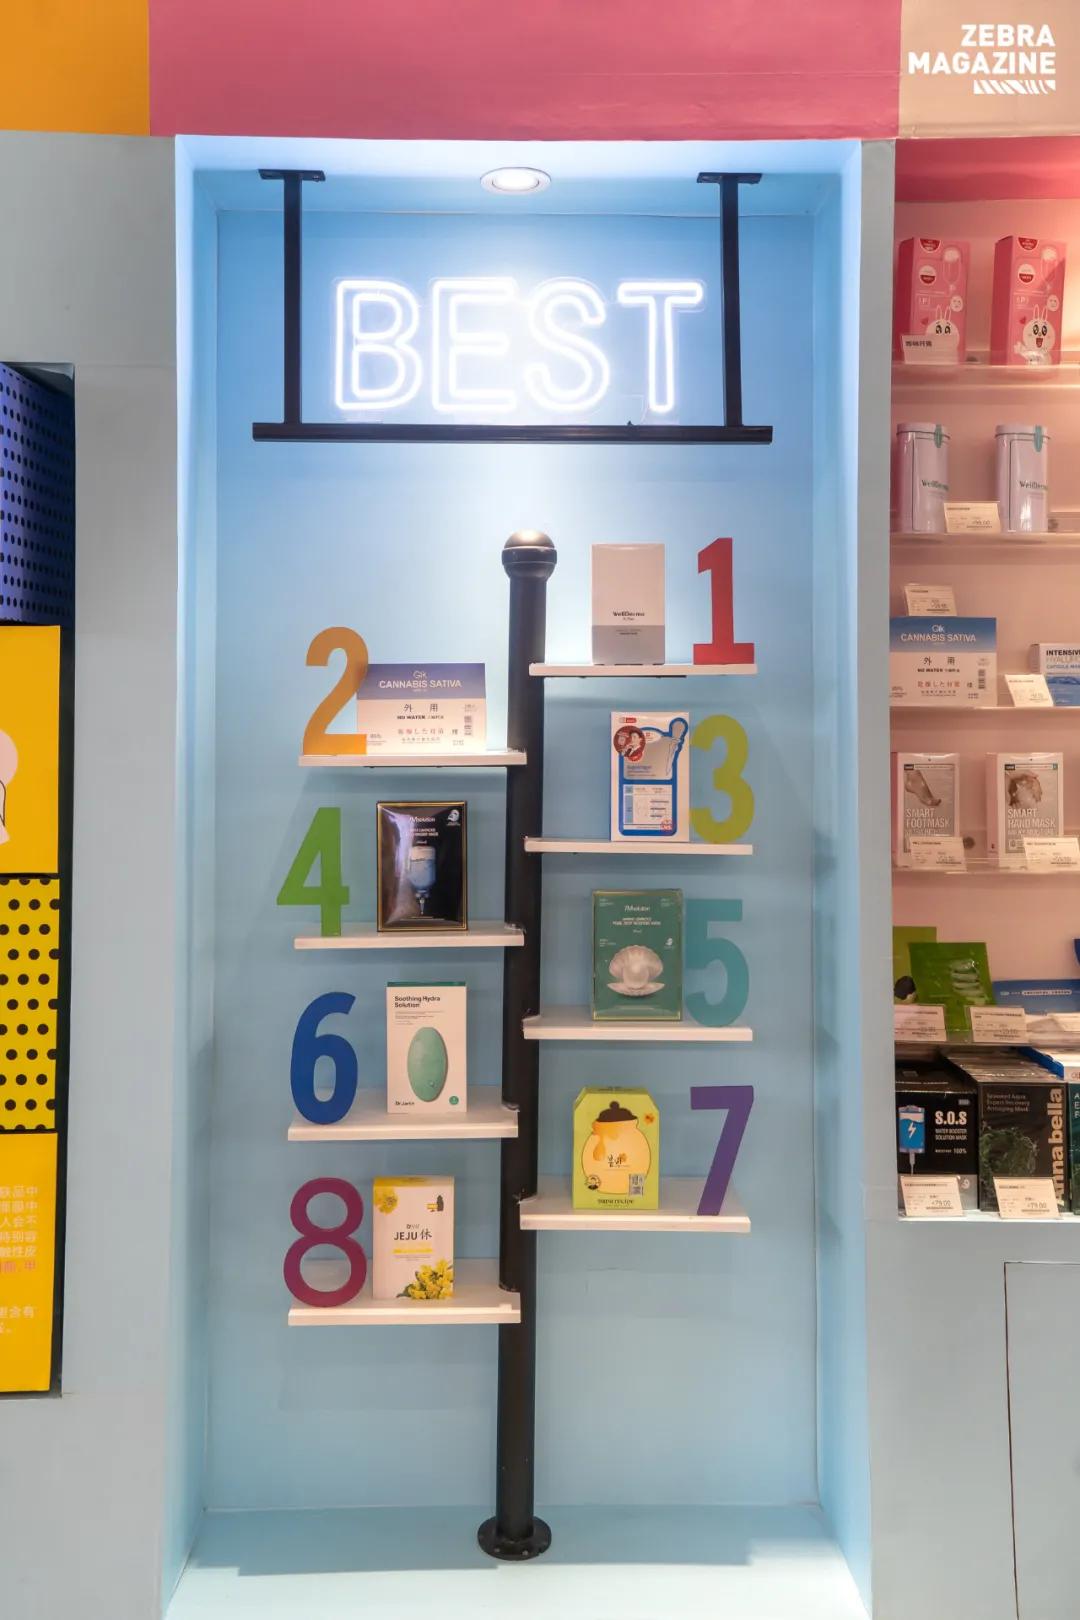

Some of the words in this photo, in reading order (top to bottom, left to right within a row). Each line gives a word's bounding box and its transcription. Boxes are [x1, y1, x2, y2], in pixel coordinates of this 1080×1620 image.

[335, 277, 703, 413] BEST
[693, 537, 755, 665] 1
[900, 633, 945, 642] CANNABIS
[946, 634, 976, 642] SATIVA
[303, 626, 369, 755] 2
[379, 681, 428, 689] CANNABIS
[429, 680, 462, 688] SATIVA
[689, 714, 755, 844] 3
[906, 808, 935, 817] SMART
[1008, 808, 1037, 817] SMART
[1032, 817, 1056, 828] MASK
[276, 807, 350, 937] 4
[685, 898, 750, 1027] 5
[290, 992, 358, 1125] 6
[935, 1111, 967, 1125] S.O.S
[1047, 1088, 1064, 1144] bella
[690, 1085, 754, 1216] 7
[283, 1177, 367, 1308] 8
[394, 1231, 418, 1240] JEJU
